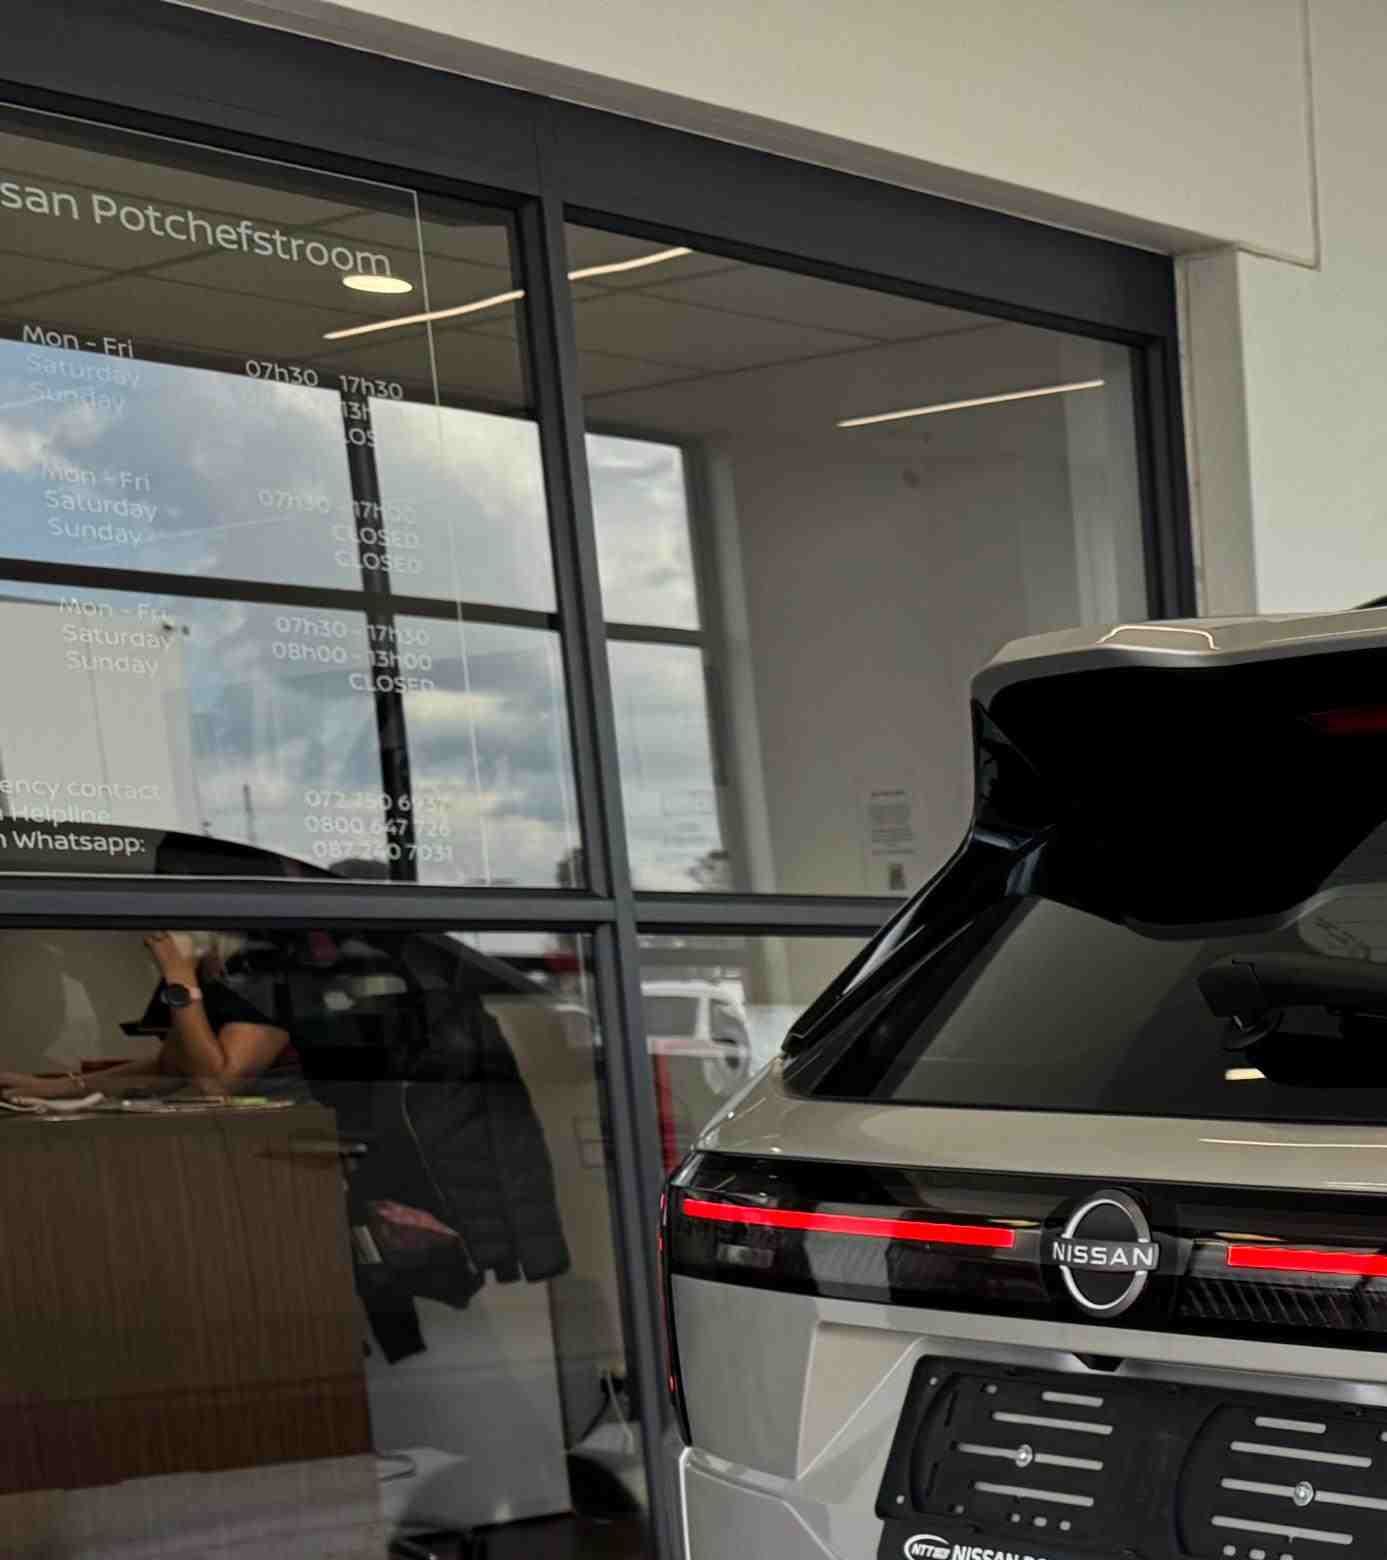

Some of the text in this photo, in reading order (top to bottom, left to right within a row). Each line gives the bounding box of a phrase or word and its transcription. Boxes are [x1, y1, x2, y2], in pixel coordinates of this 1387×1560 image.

[93, 194, 392, 275] Potchefstroom
[22, 324, 79, 350] Mon
[103, 336, 134, 358] Fri
[26, 352, 140, 390] Saturday
[245, 359, 403, 400] 07h30 17h30
[119, 470, 152, 492] Fri
[44, 489, 158, 523] Saturday
[48, 517, 144, 545] Sunday
[332, 524, 420, 548] CLOSED
[335, 549, 424, 575] CLOSED
[59, 596, 113, 617] Mon
[63, 623, 175, 652] Saturday
[276, 615, 347, 639] 07h30
[368, 623, 431, 646] 17h30
[65, 650, 159, 679] Sunday
[272, 641, 347, 665] 08h00
[369, 649, 433, 672] 13h00
[349, 672, 435, 694] CLOSED
[67, 780, 161, 801] contact
[10, 800, 112, 828] Helpline
[304, 815, 364, 835] 0800
[12, 830, 146, 857] Whatsapp:
[1052, 1241, 1154, 1267] NISSAN
